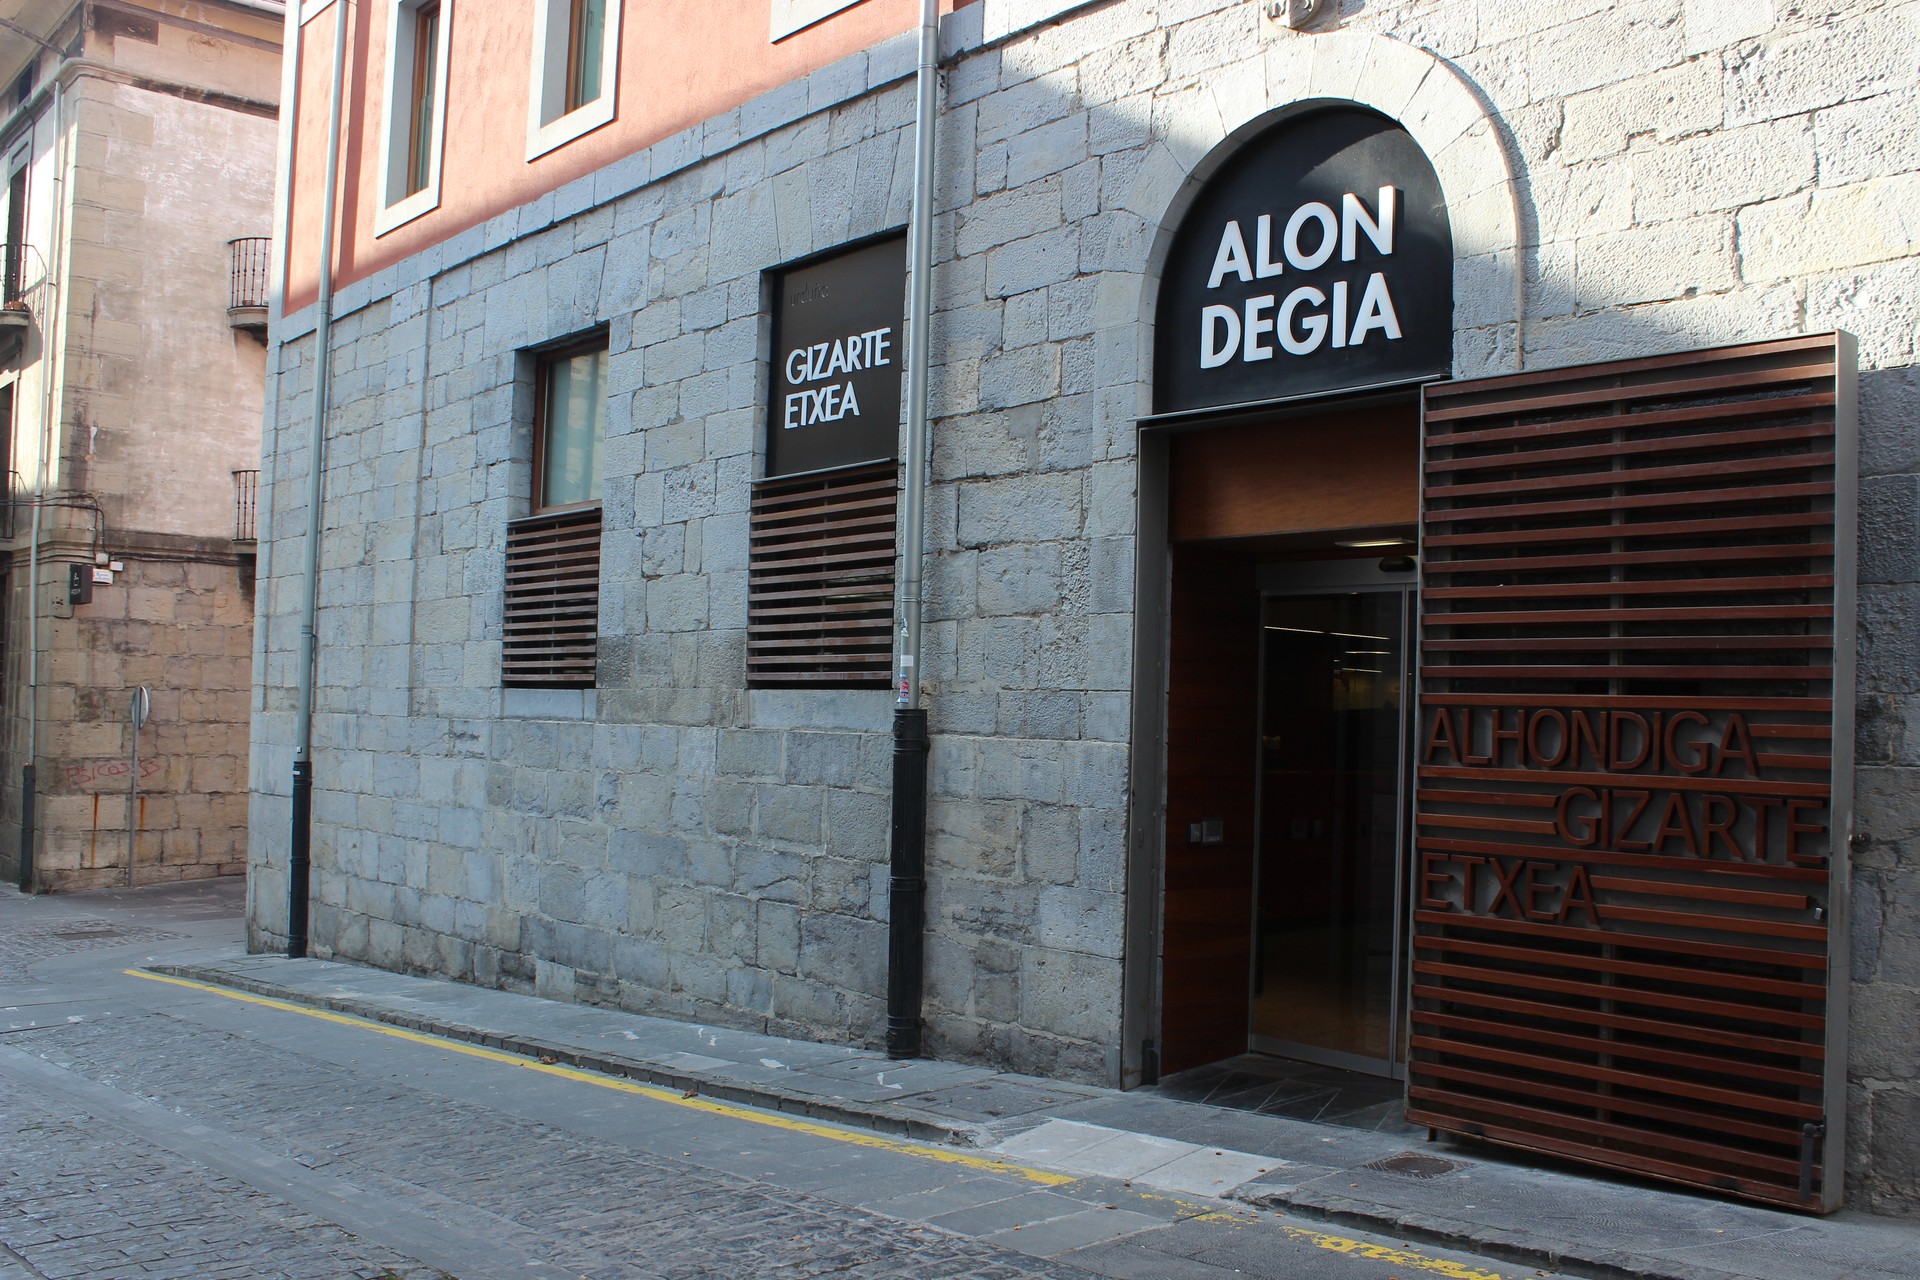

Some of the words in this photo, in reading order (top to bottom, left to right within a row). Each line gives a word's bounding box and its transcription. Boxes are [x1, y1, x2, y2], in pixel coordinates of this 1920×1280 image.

[1206, 184, 1396, 289] ALON
[785, 327, 892, 385] GIZARTE
[1200, 272, 1402, 370] DEGIA
[784, 381, 860, 430] ETXEA
[1425, 708, 1757, 776] ALHONDIGA
[1556, 786, 1827, 864] GIZARTE
[1421, 852, 1600, 925] ETXEA
